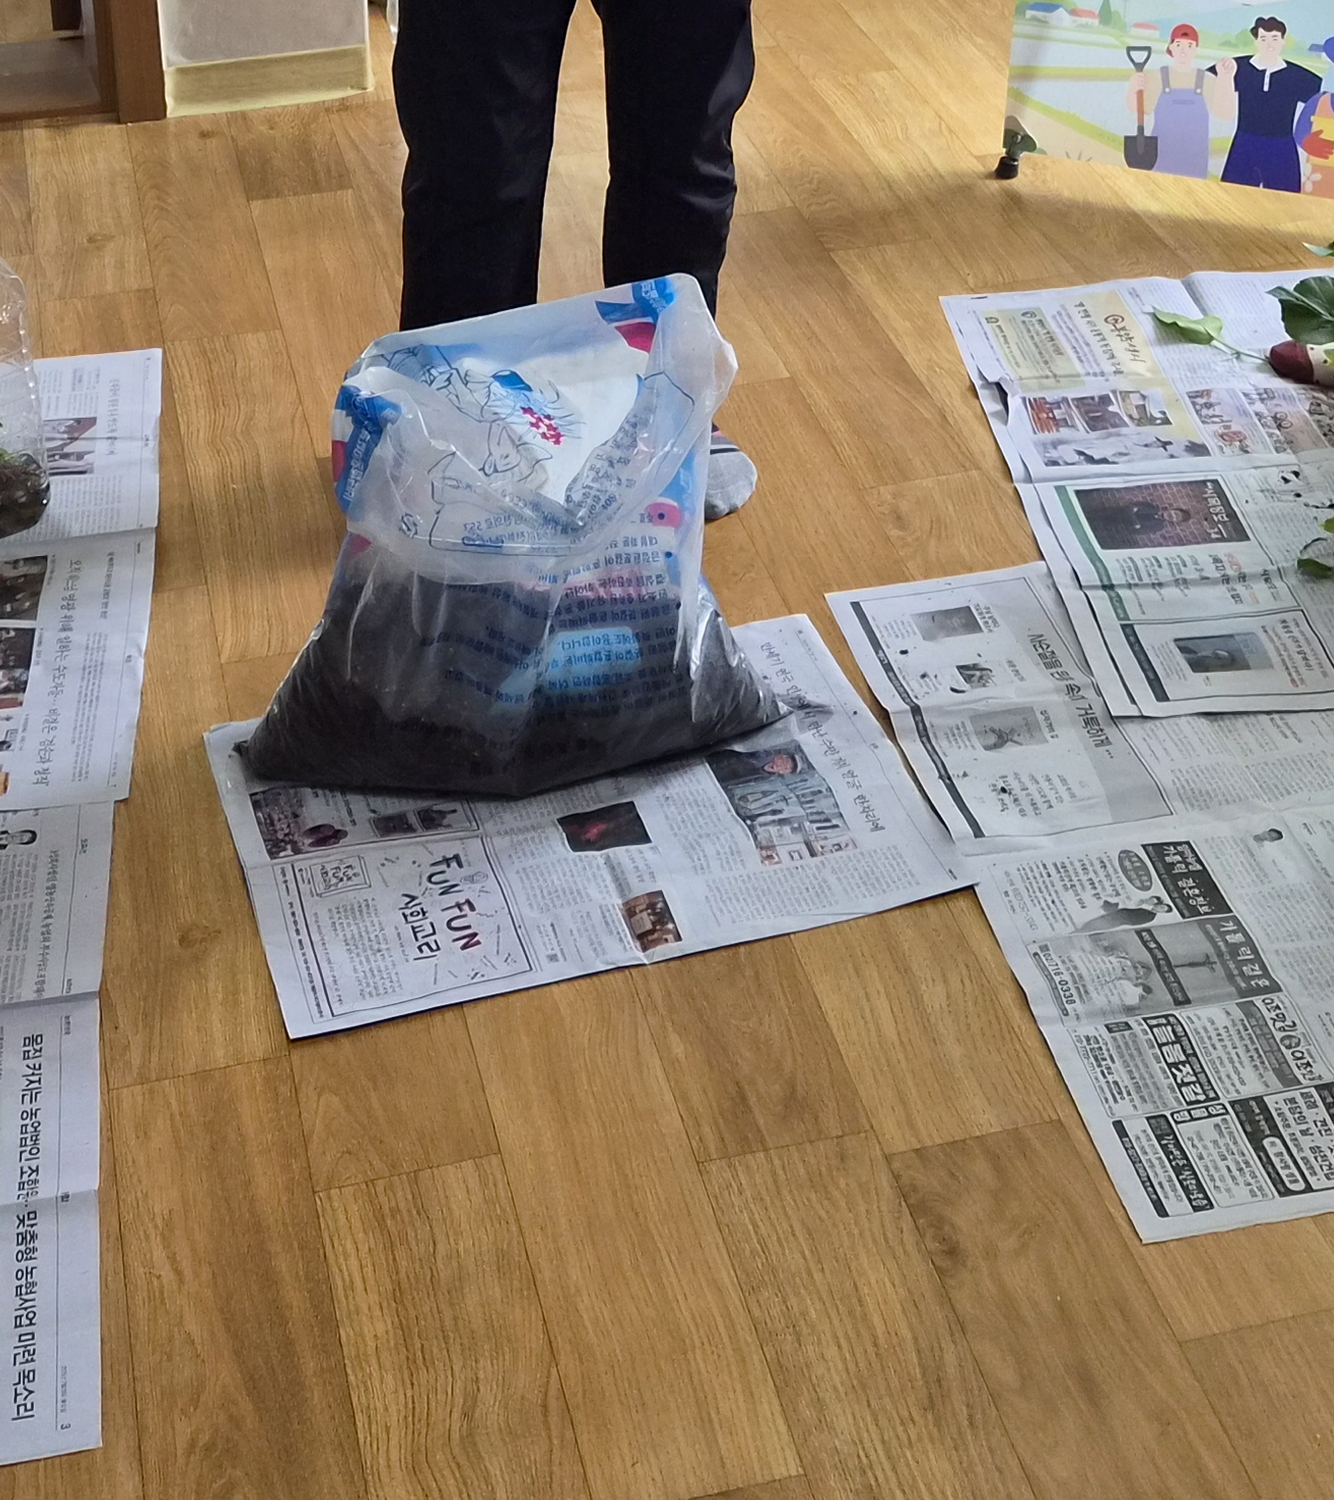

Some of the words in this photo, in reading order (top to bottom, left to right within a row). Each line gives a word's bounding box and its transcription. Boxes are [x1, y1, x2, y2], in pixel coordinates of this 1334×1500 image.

[426, 853, 464, 897] FUN
[398, 893, 441, 961] 사회교리
[441, 899, 482, 951] FUN
[20, 1064, 43, 1105] 커지는
[19, 1107, 42, 1162] 농업법인
[13, 1211, 39, 1263] 맞춤형
[14, 1266, 38, 1329] 농협사업
[13, 1332, 37, 1369] 마련
[12, 1372, 36, 1422] 목소리
